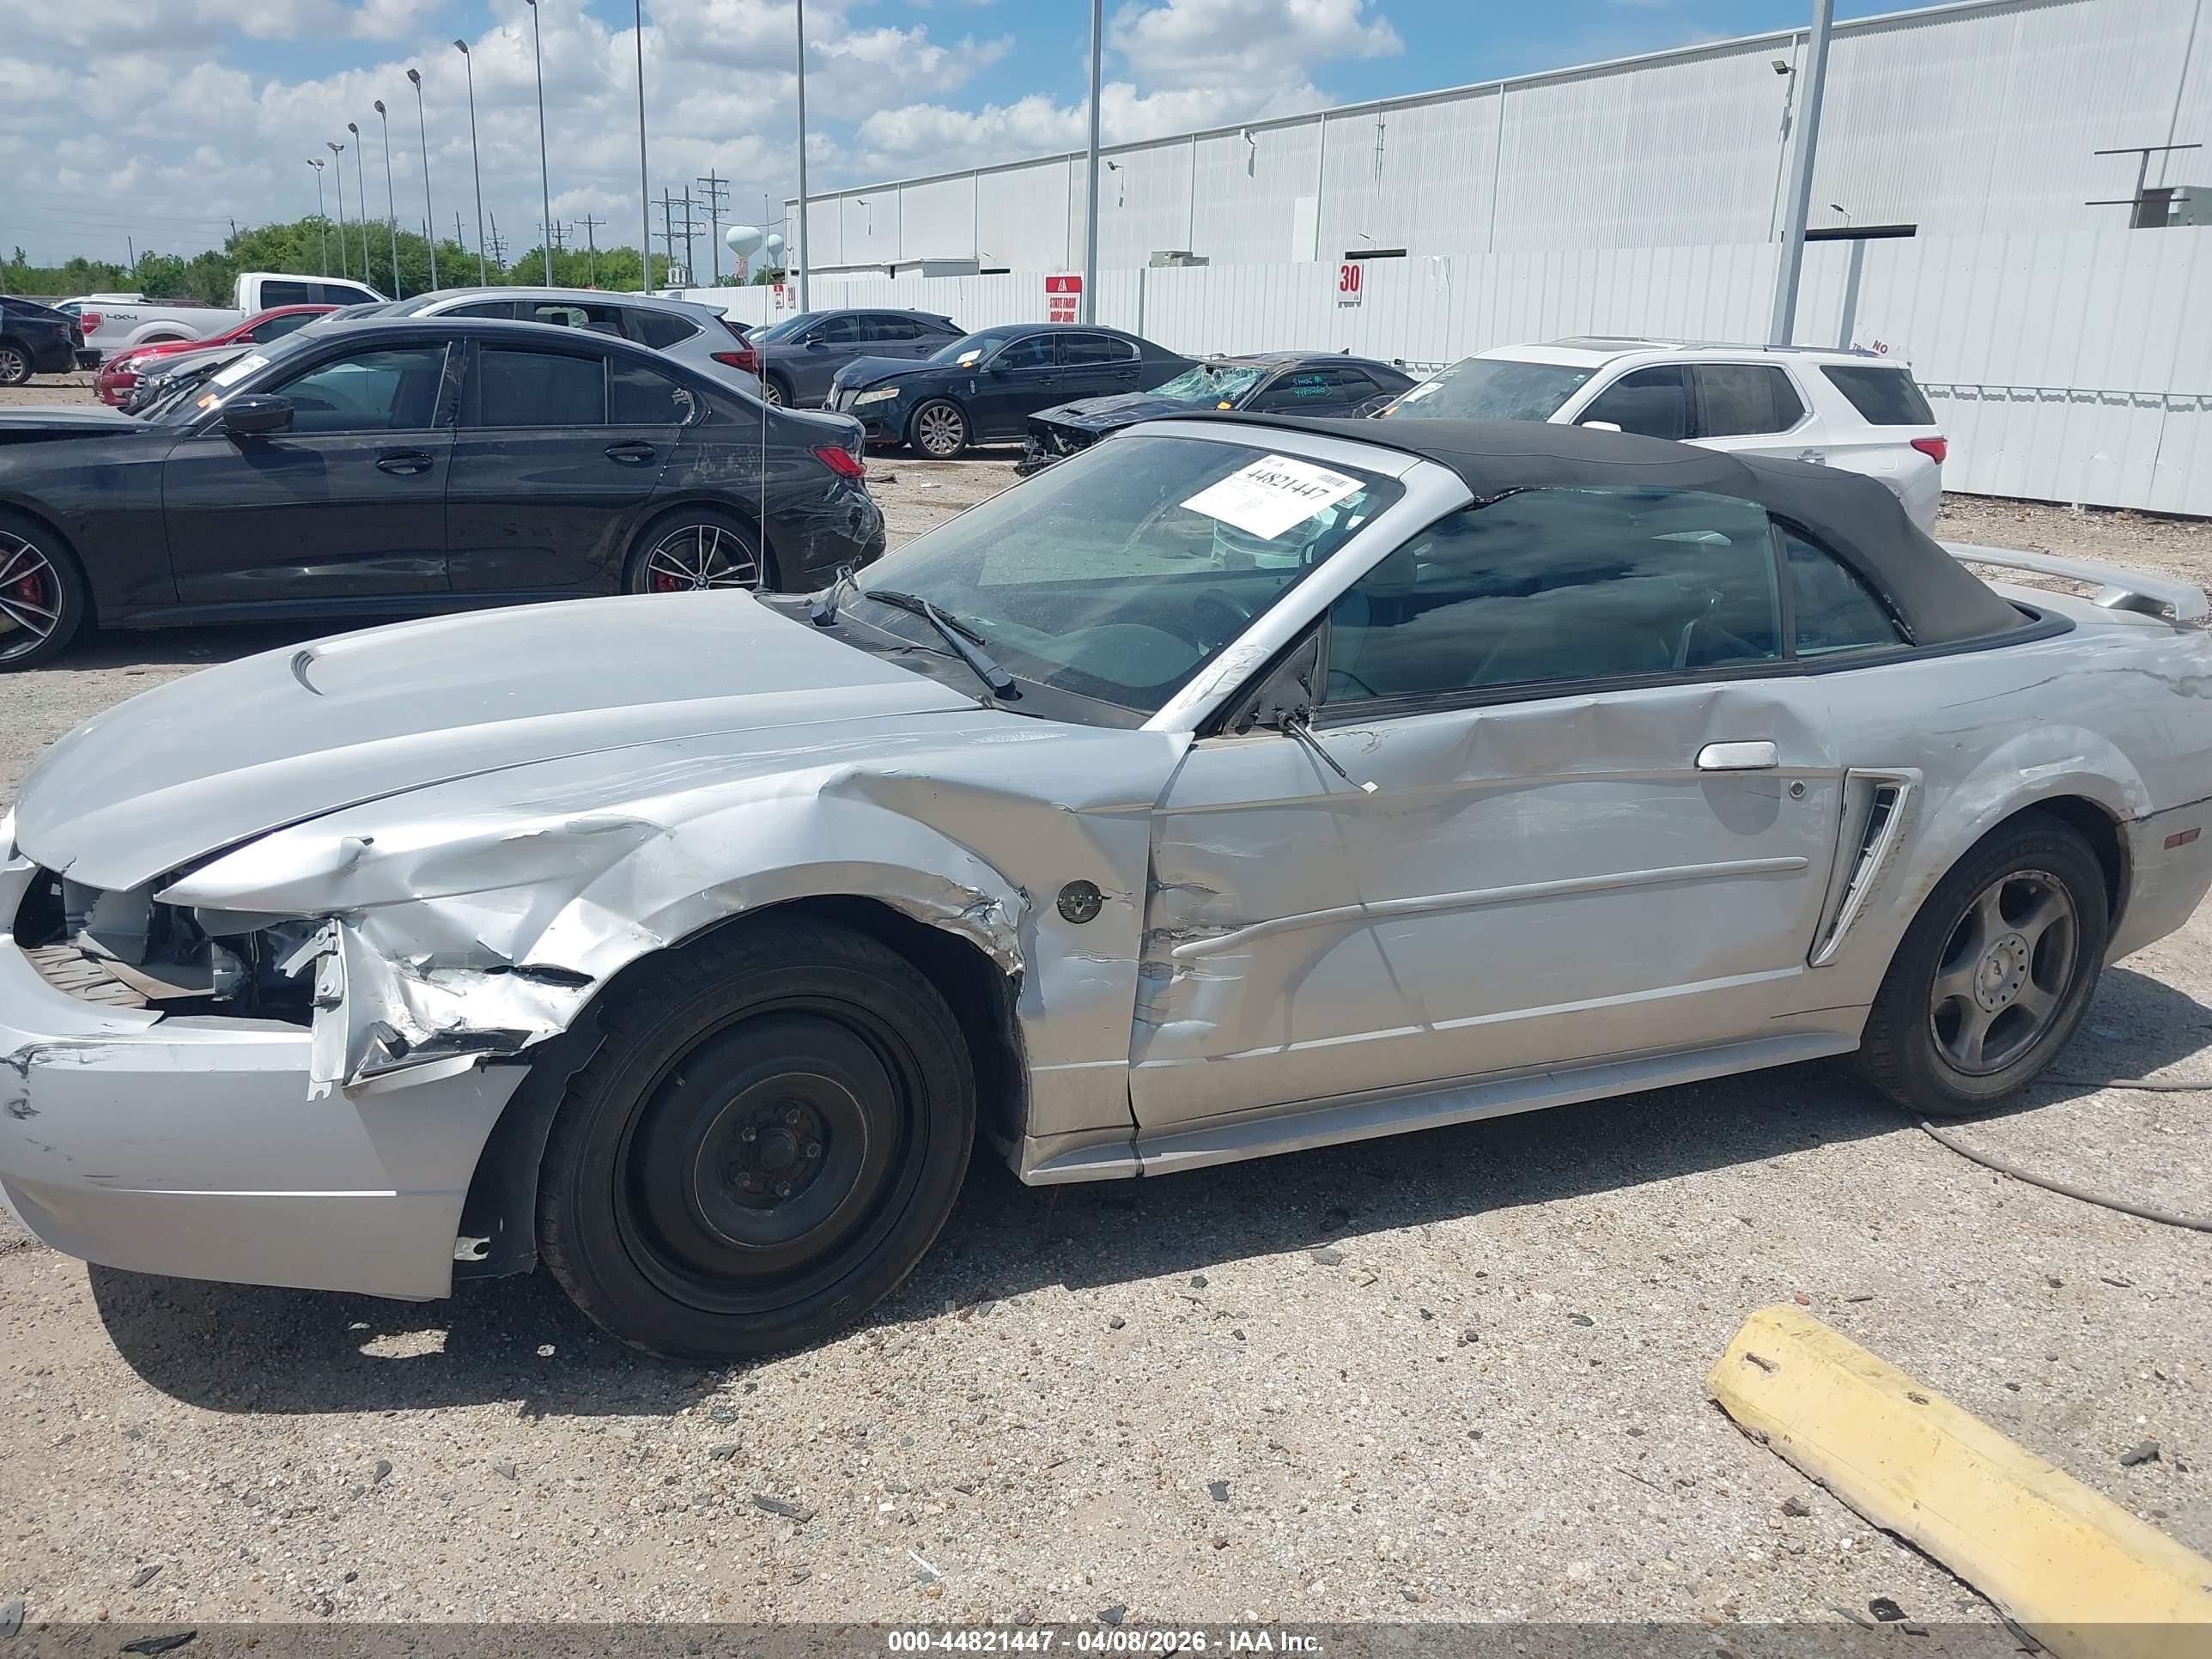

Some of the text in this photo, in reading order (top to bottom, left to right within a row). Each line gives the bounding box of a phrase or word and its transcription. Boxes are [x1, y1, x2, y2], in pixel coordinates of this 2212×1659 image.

[1340, 264, 1360, 292] 30
[1049, 297, 1076, 309] STATE FARM
[1050, 311, 1074, 323] DROP ZONE
[1873, 339, 1888, 354] NO
[1246, 470, 1330, 500] 44821447
